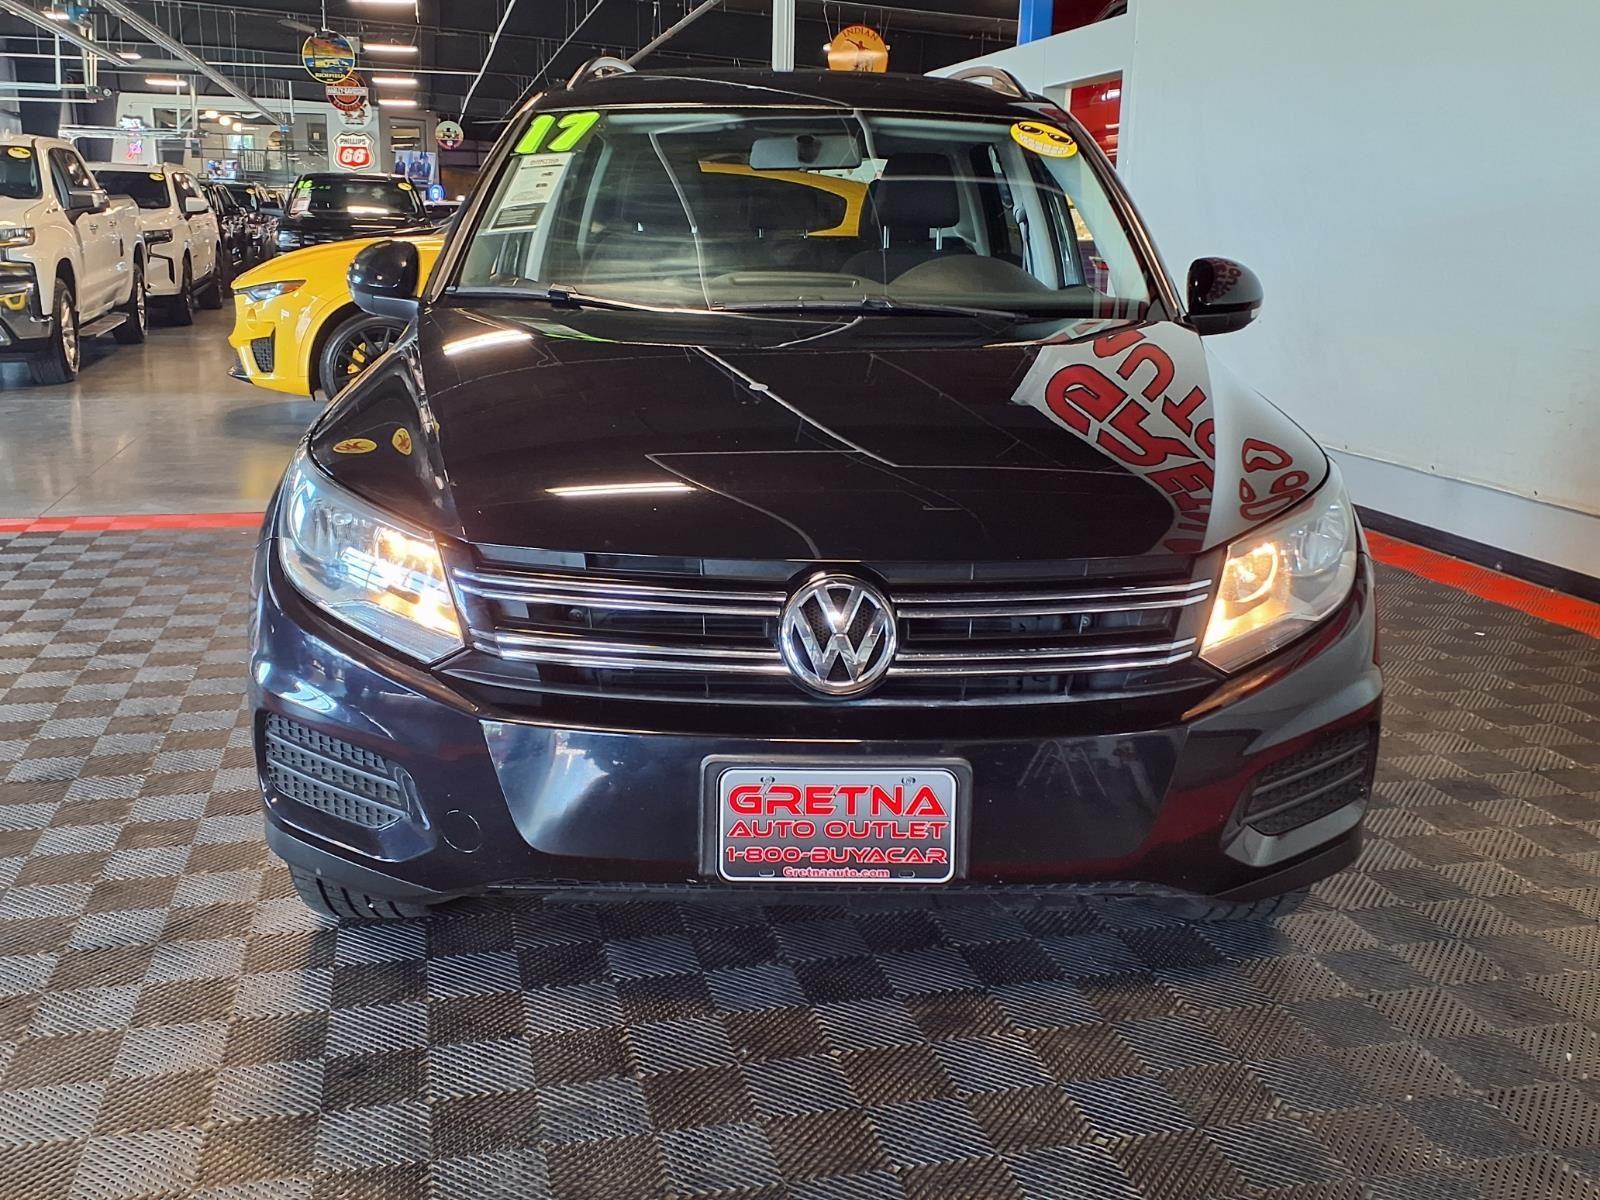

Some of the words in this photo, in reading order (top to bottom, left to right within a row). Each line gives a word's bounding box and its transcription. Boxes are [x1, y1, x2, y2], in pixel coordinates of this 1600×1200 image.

[842, 27, 879, 41] INDIAN
[514, 111, 600, 154] 17
[341, 148, 366, 163] 66
[728, 784, 949, 817] GRETNA
[727, 819, 816, 838] AUTO
[823, 820, 949, 839] OUTLET
[726, 847, 948, 864] 1-800-BUYACAR
[783, 866, 890, 878] Gretnaauto.com
